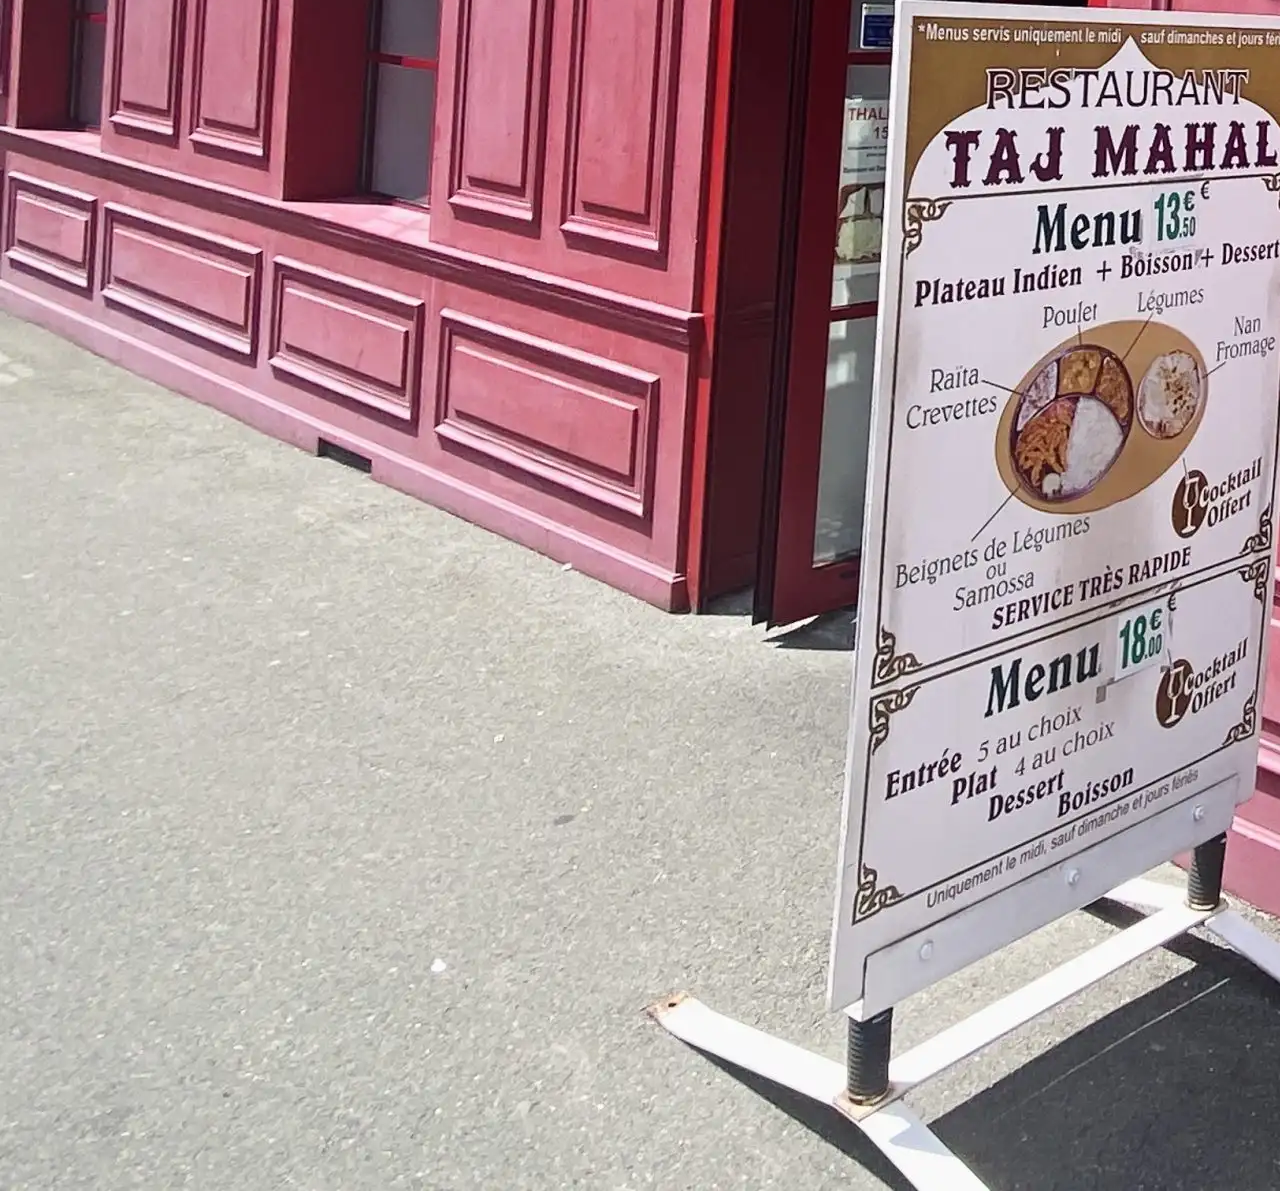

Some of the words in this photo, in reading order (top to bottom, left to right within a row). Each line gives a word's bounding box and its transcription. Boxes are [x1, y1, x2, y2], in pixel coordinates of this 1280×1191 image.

[973, 27, 1010, 42] servis
[1014, 25, 1083, 46] uniquement
[1086, 28, 1095, 43] le
[1098, 28, 1122, 43] midi
[1140, 30, 1165, 44] sauf
[1167, 30, 1228, 46] dimanches
[1226, 31, 1236, 45] et
[1236, 32, 1263, 48] jours
[985, 68, 1249, 110] RESTAURANT
[944, 126, 1065, 189] TAJ
[1091, 120, 1278, 179] MAHAL
[1032, 203, 1142, 255] Menu
[914, 272, 1005, 308] Plateau
[1012, 263, 1083, 294] Indien
[1096, 261, 1112, 281] +
[1120, 252, 1193, 279] Boisson
[1200, 248, 1214, 267] +
[1221, 240, 1280, 265] Dessert
[1042, 301, 1098, 328] Poulet
[1136, 288, 1205, 314] Légumes
[1233, 316, 1262, 337] Nan
[1215, 335, 1276, 362] Fromage
[929, 364, 980, 393] Raïta
[906, 394, 998, 430] Crevettes
[1199, 456, 1262, 508] Cocktail
[1207, 489, 1251, 527] Offert
[895, 548, 978, 589] Beignets
[984, 538, 1007, 562] de
[1012, 516, 1090, 553] Légumes
[985, 562, 1007, 581] ou
[953, 571, 1035, 611] Samossa
[991, 588, 1074, 630] SERVICE
[1079, 565, 1123, 601] TRÈS
[1128, 546, 1191, 585] RAPIDE
[984, 641, 1100, 718] Menu
[1184, 637, 1248, 696] Cocktail
[1192, 672, 1236, 713] Offert
[884, 748, 962, 800] Entrée
[977, 740, 989, 762] 5
[996, 730, 1021, 755] au
[1028, 706, 1083, 741] choix
[951, 765, 998, 806] Plat
[1014, 757, 1026, 776] 4
[1032, 746, 1056, 770] au
[1062, 720, 1115, 756] choix
[988, 769, 1065, 822] Dessert
[1057, 767, 1134, 818] Boisson
[927, 861, 1003, 908] Uniquement
[1005, 855, 1017, 870] le
[1020, 839, 1047, 864] midi,
[1051, 824, 1076, 850] sauf
[1077, 803, 1129, 836] dimanche
[1132, 794, 1144, 810] et
[1144, 783, 1170, 809] jours
